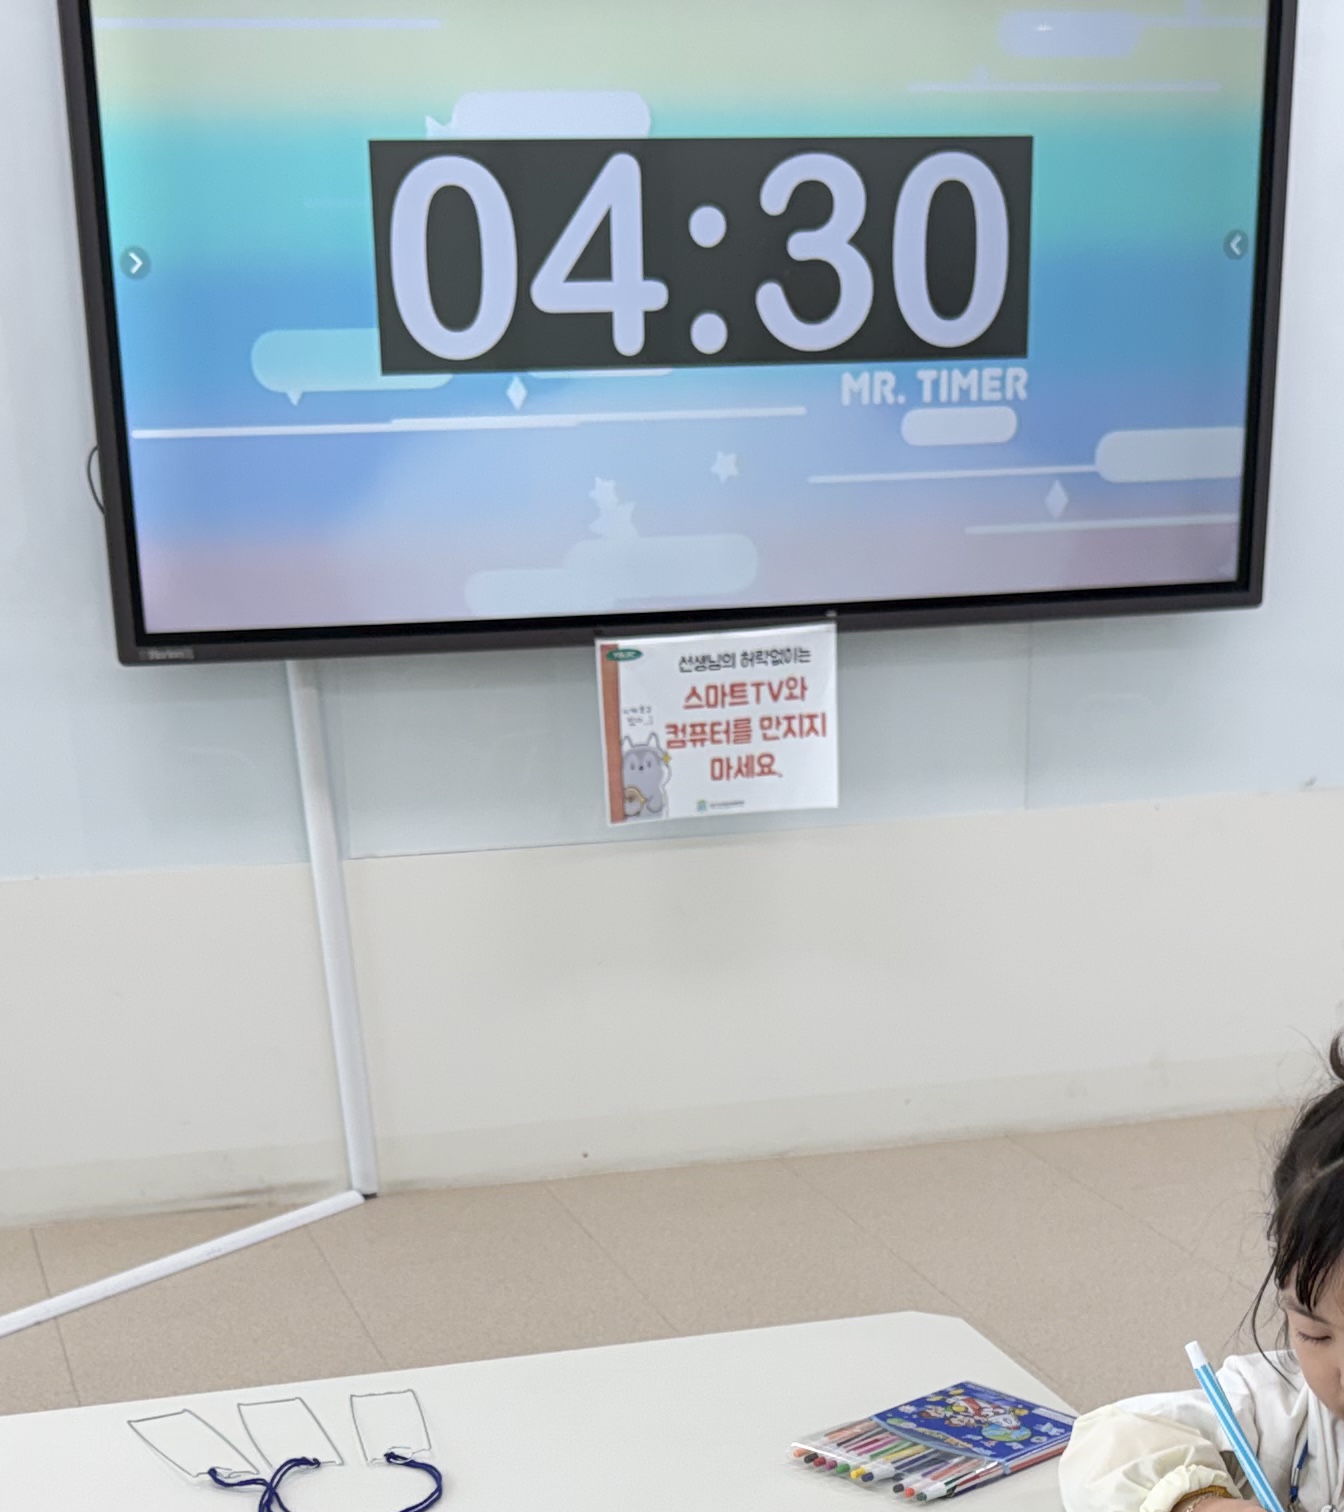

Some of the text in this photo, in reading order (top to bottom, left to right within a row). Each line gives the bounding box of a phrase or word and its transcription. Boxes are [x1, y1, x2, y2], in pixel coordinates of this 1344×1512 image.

[390, 151, 1008, 360] 04:30
[841, 367, 1028, 406] MR. TIMER
[679, 653, 736, 673] 선생님의
[683, 676, 808, 709] 스마트TV와
[665, 716, 753, 749] 컴퓨터를
[759, 712, 827, 741] 만지지
